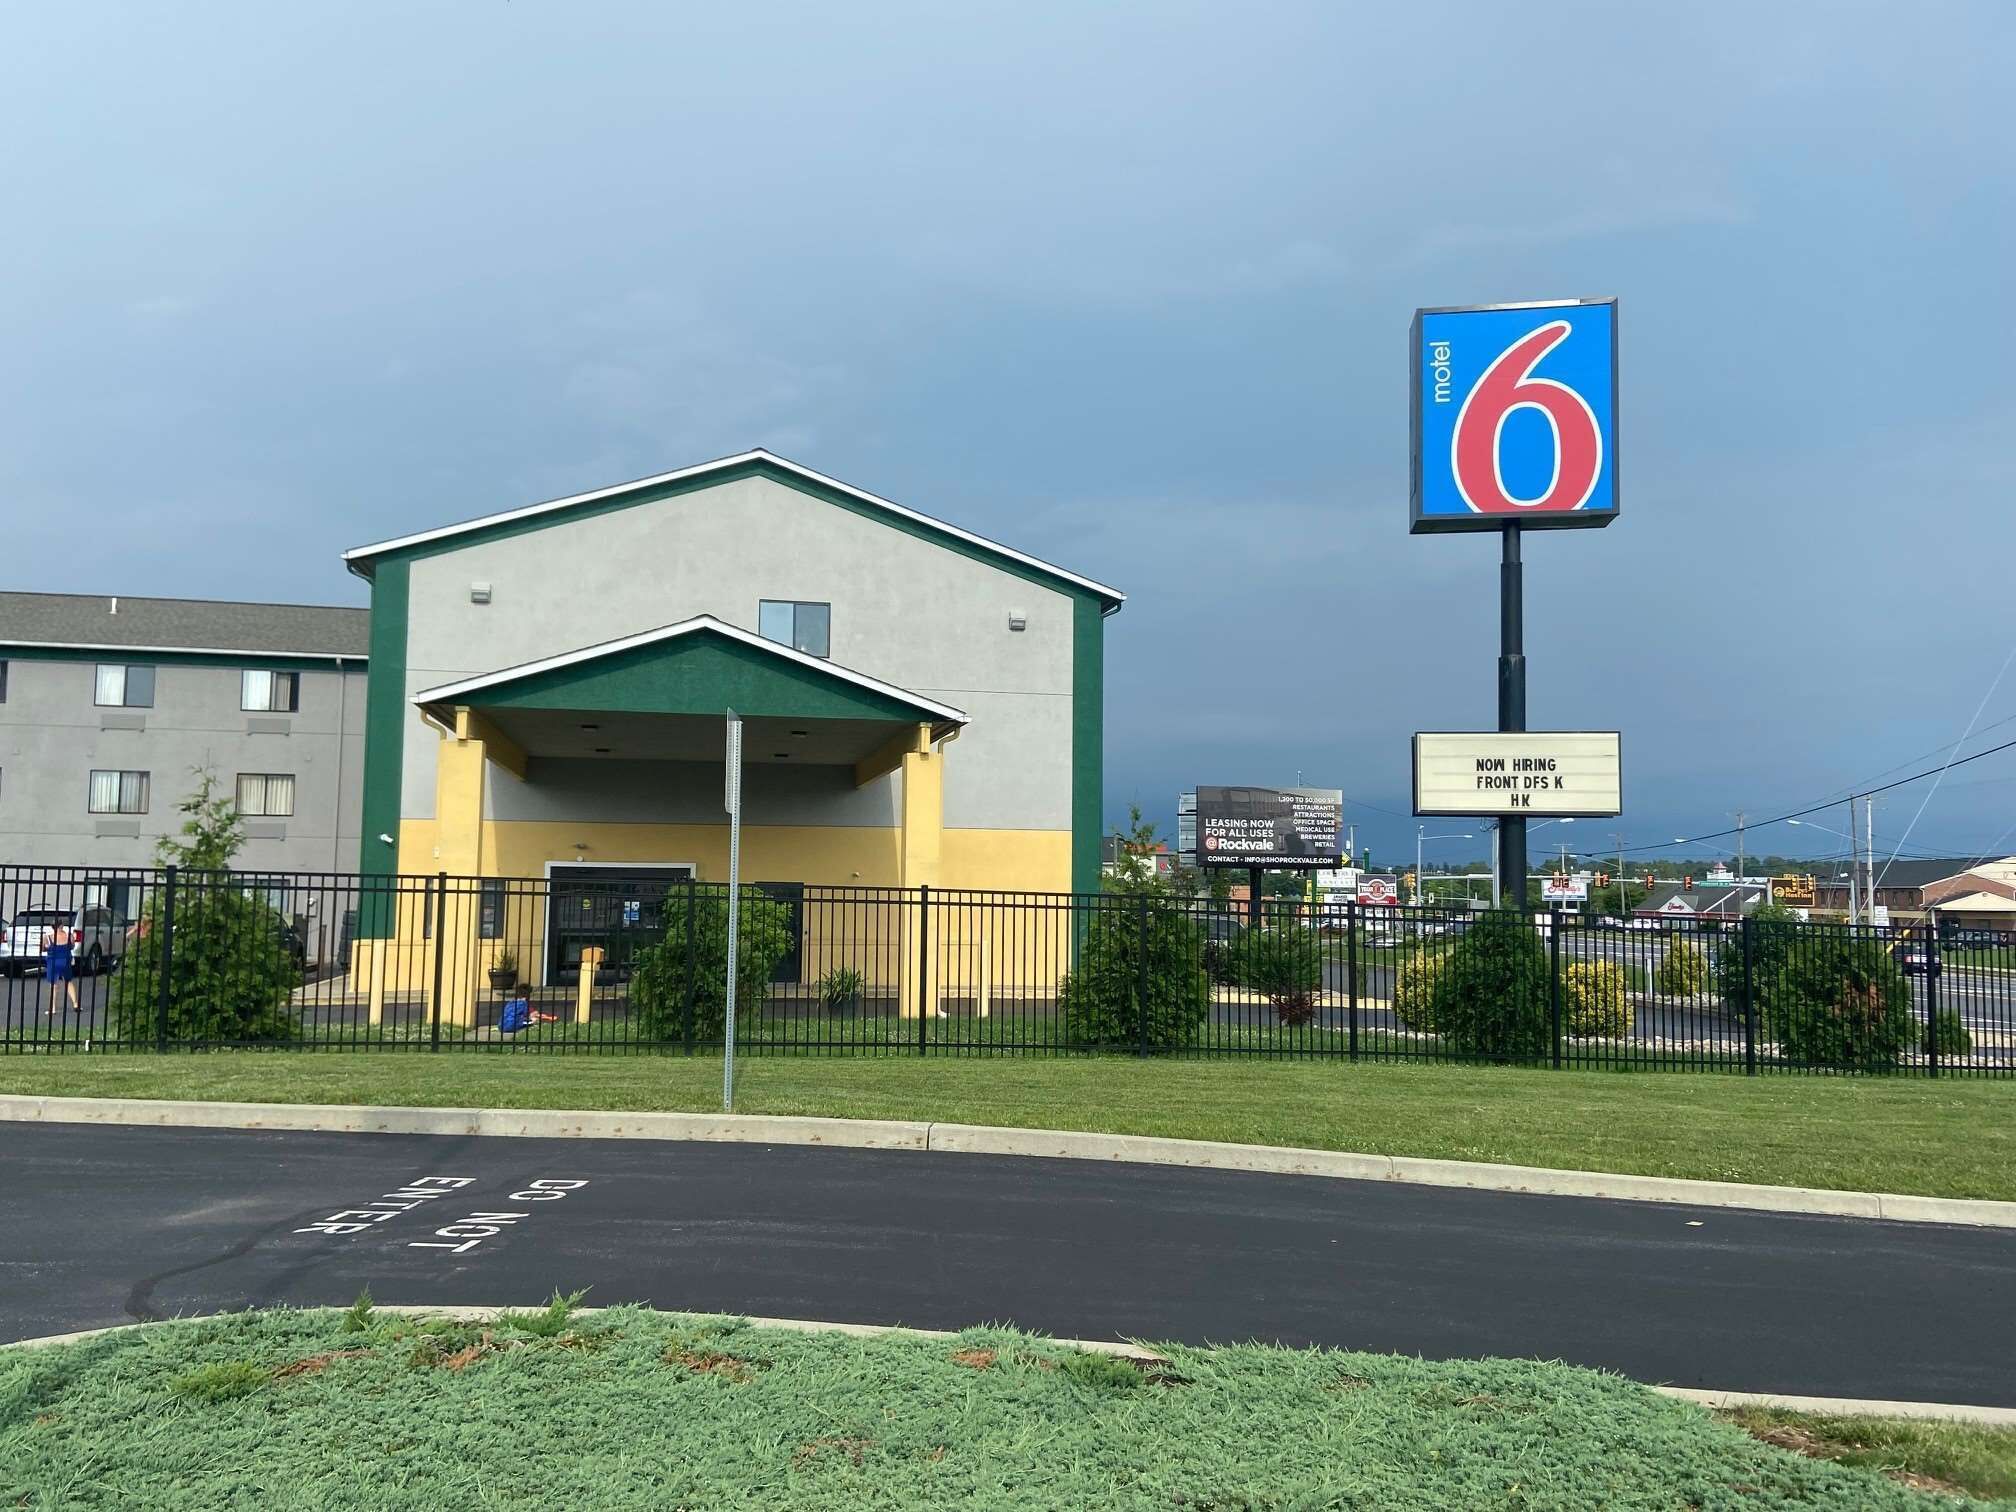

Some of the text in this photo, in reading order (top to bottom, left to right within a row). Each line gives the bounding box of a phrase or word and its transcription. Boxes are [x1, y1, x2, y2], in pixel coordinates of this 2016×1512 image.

[1429, 341, 1450, 403] motel
[1451, 319, 1603, 513] 6
[1476, 758, 1556, 771] NOW HIRING
[1477, 776, 1519, 789] FRONT
[1205, 818, 1275, 828] LEASING NOW
[1205, 827, 1274, 838] FOR ALL USES
[1207, 855, 1334, 864] CONTACT INFO@SHOPROCKVALE.COM
[293, 1176, 477, 1234] ENTER
[407, 1179, 589, 1253] DO NOT
